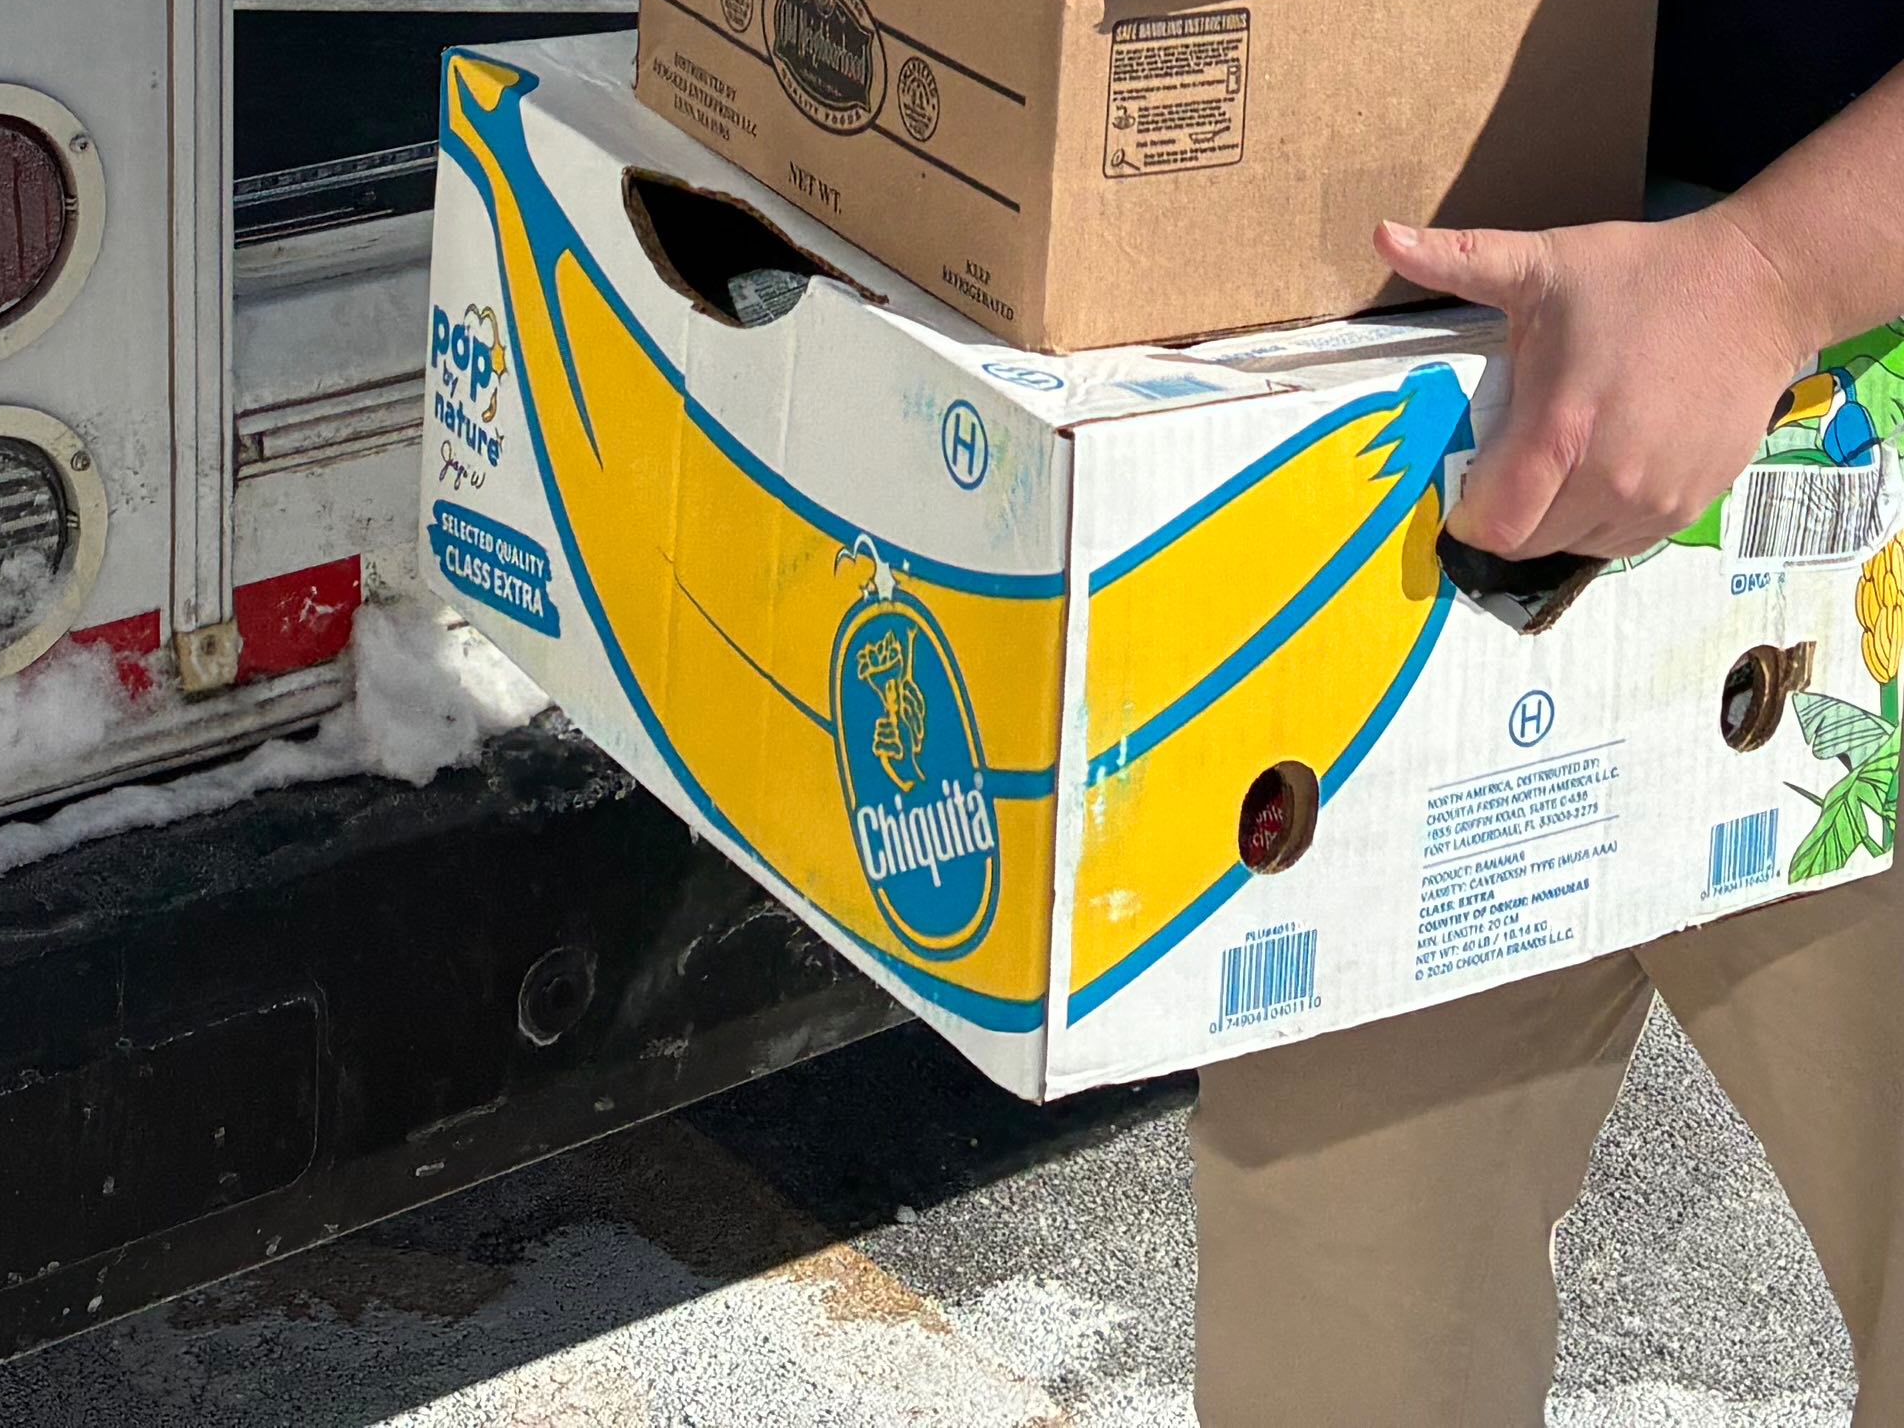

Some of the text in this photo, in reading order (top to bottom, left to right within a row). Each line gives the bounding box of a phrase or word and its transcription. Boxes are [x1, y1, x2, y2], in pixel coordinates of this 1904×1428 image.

[1115, 12, 1247, 41] SAFE HANDLING INSTRUCTIONS
[781, 67, 819, 120] QUALITY
[789, 160, 842, 215] NET WT.
[965, 258, 992, 285] KEEP
[431, 303, 493, 403] pop
[434, 389, 501, 468] nature
[441, 511, 545, 578] SELECTED QUALITY
[445, 543, 544, 618] CLASS EXTRA
[1426, 804, 1474, 826] CHIQUITA
[1476, 793, 1509, 813] FRESH
[1511, 785, 1547, 805] NORTH
[1548, 774, 1593, 795] AMERICA
[1427, 792, 1463, 810] NORTH
[1516, 761, 1581, 788] DISTRIBUTED
[1529, 798, 1558, 816] SUITE
[856, 777, 995, 889] Chiquita
[1423, 840, 1451, 859] FORT
[1524, 817, 1536, 831] FL
[1469, 866, 1527, 890] CAVENDISH
[1530, 857, 1555, 875] TYPE
[1475, 850, 1526, 874] BANANAS
[1418, 910, 1471, 935] COUNTRY
[1472, 906, 1487, 921] OF
[1531, 877, 1590, 905] HONDURAS
[1458, 889, 1495, 909] EXTRA
[1503, 912, 1519, 927] CM
[1415, 950, 1438, 966] NET
[1477, 935, 1490, 950] LB
[1533, 920, 1548, 934] KG
[1456, 945, 1504, 970] CHIQUITA
[1506, 934, 1548, 957] BRANDS
[1209, 995, 1322, 1035] 0 74904 04011 0
